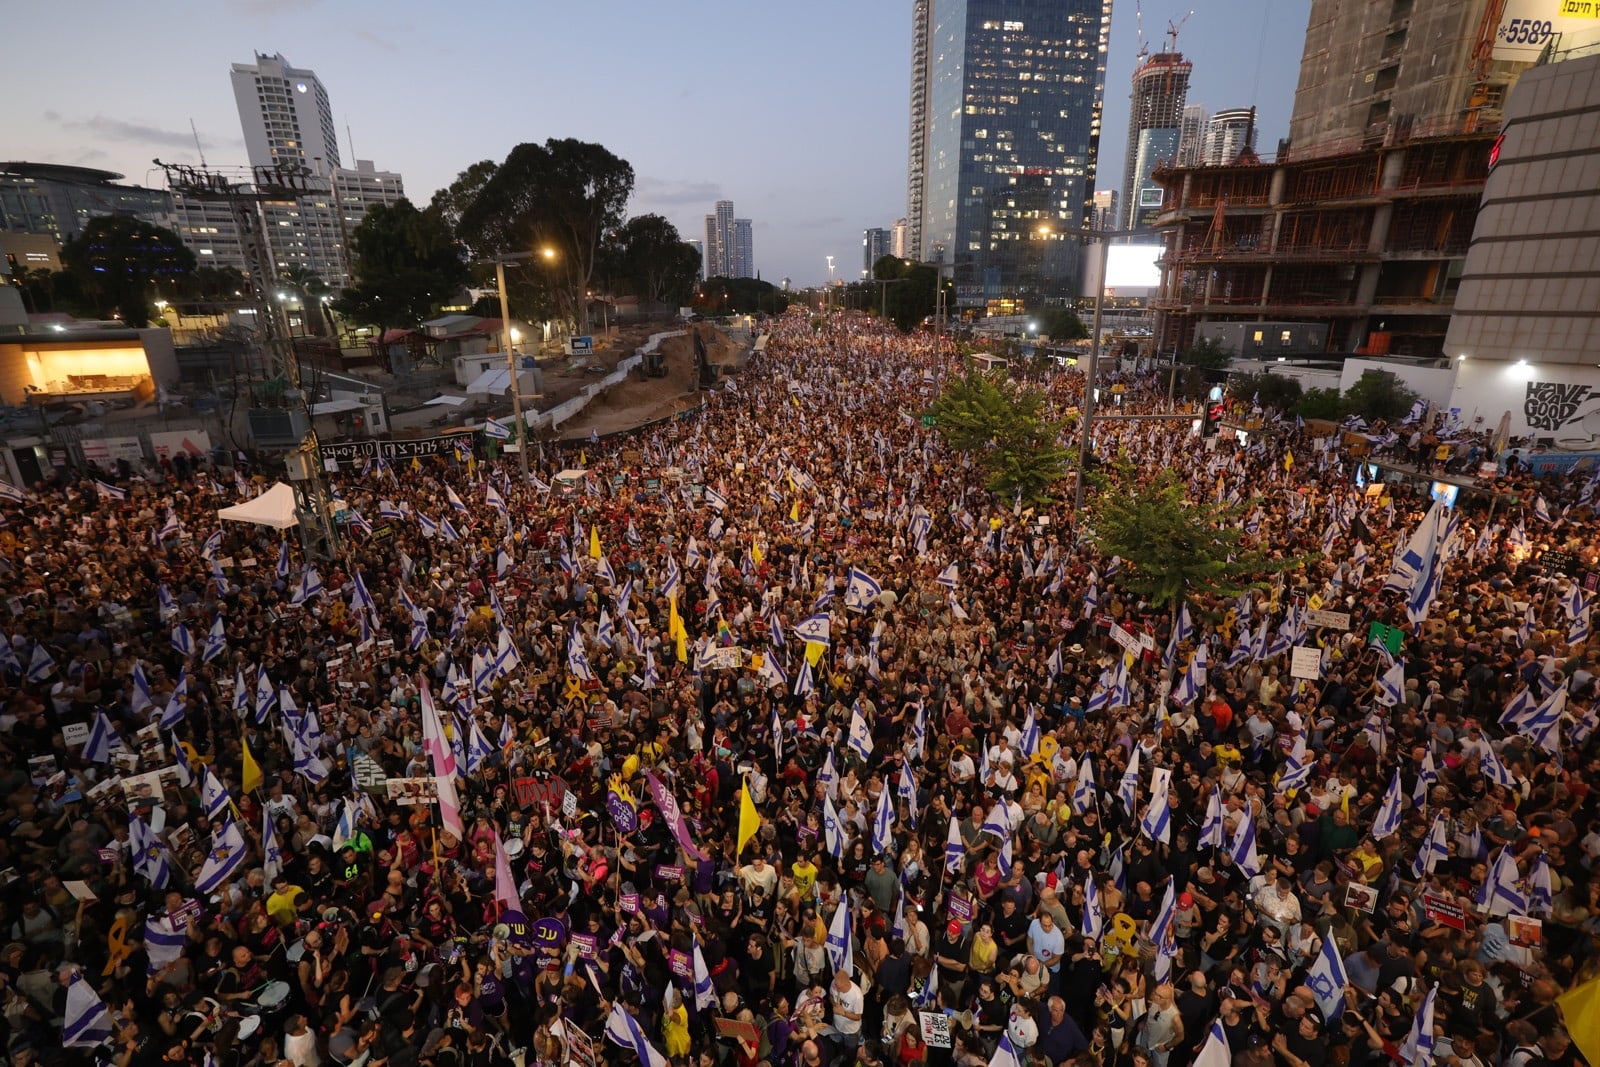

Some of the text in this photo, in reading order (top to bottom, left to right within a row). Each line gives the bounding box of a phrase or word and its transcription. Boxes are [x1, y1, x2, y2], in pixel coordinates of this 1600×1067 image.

[1524, 399, 1578, 419] GOOD
[1527, 416, 1567, 431] DAY
[345, 864, 358, 879] 64
[508, 923, 525, 935] שי
[538, 926, 558, 940] עכ
